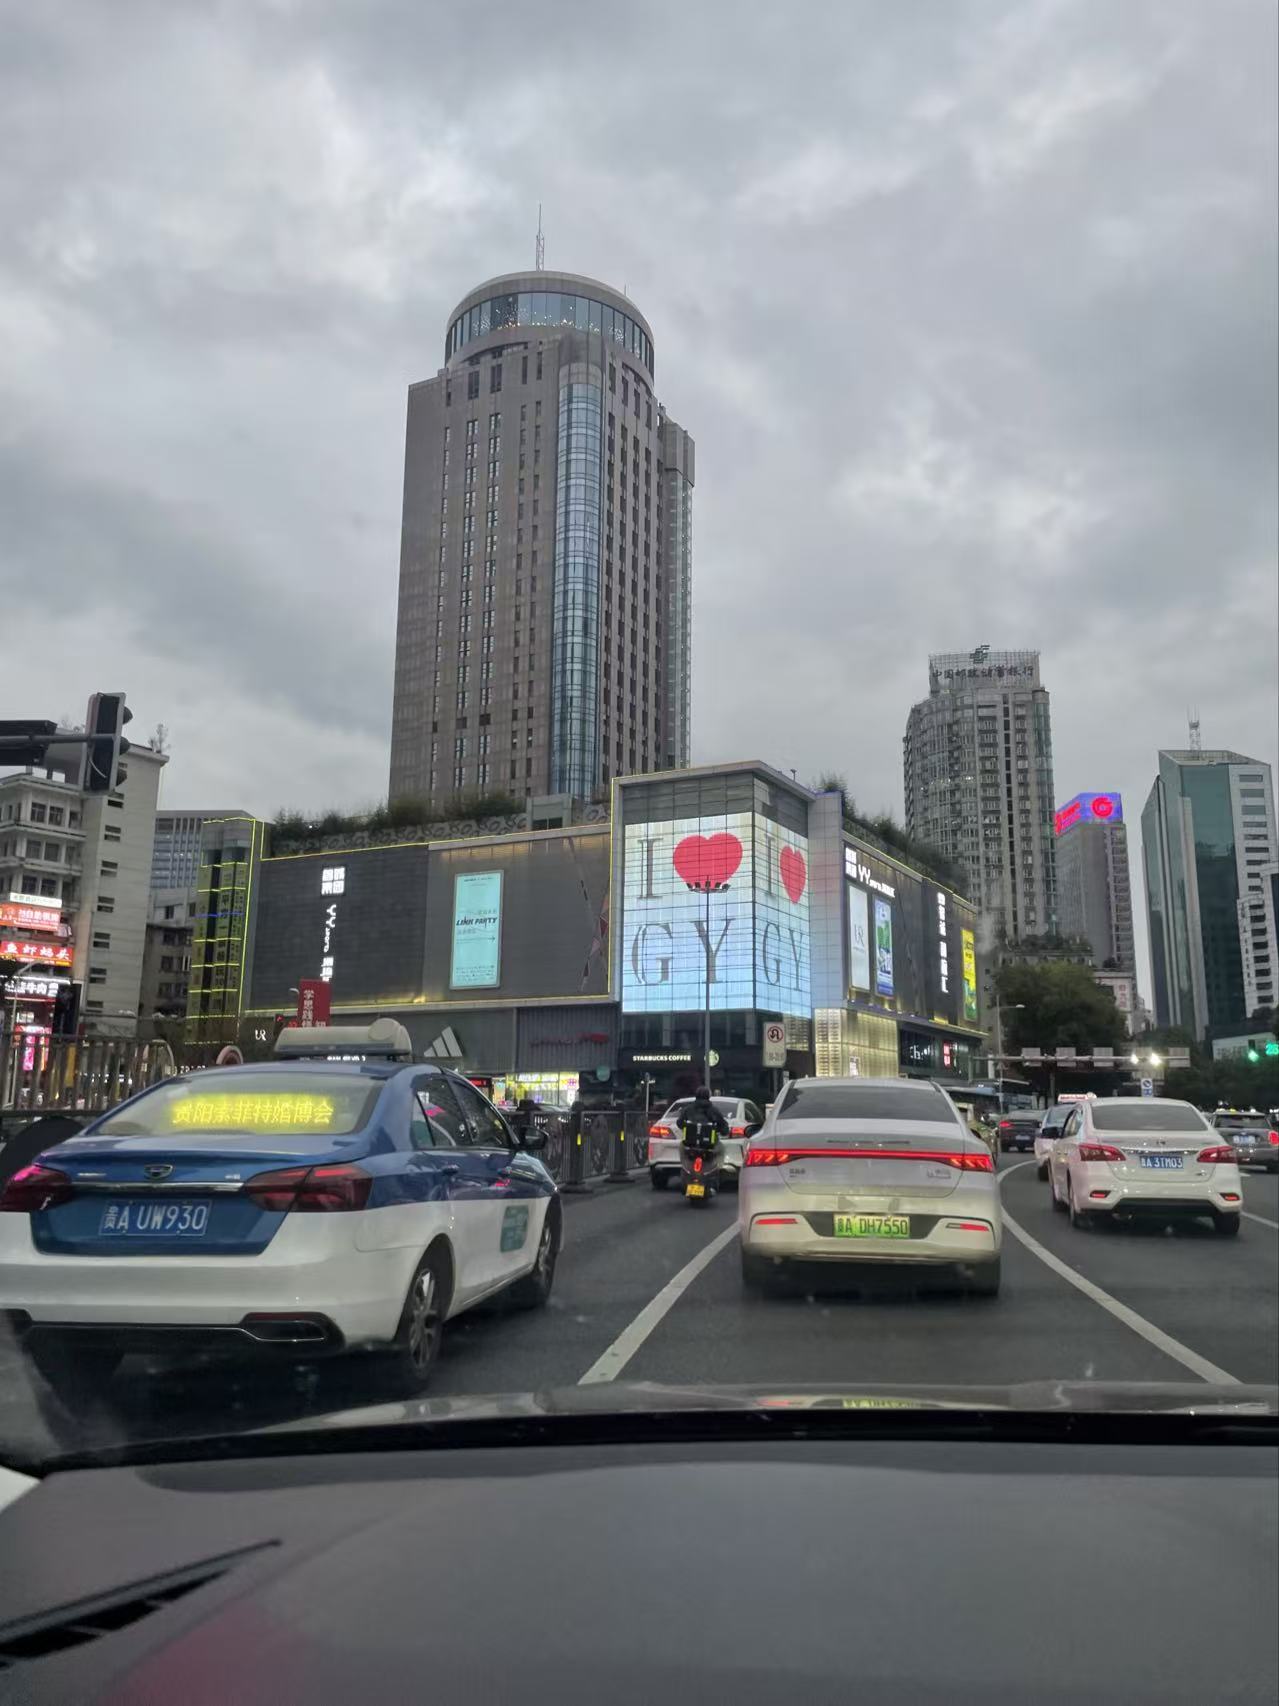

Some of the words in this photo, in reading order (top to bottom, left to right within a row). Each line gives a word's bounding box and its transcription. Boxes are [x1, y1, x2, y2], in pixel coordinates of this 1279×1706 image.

[637, 837, 663, 899] I
[632, 917, 736, 985] GY
[632, 1054, 668, 1062] STARBUCKS
[668, 1054, 692, 1062] COFFEE
